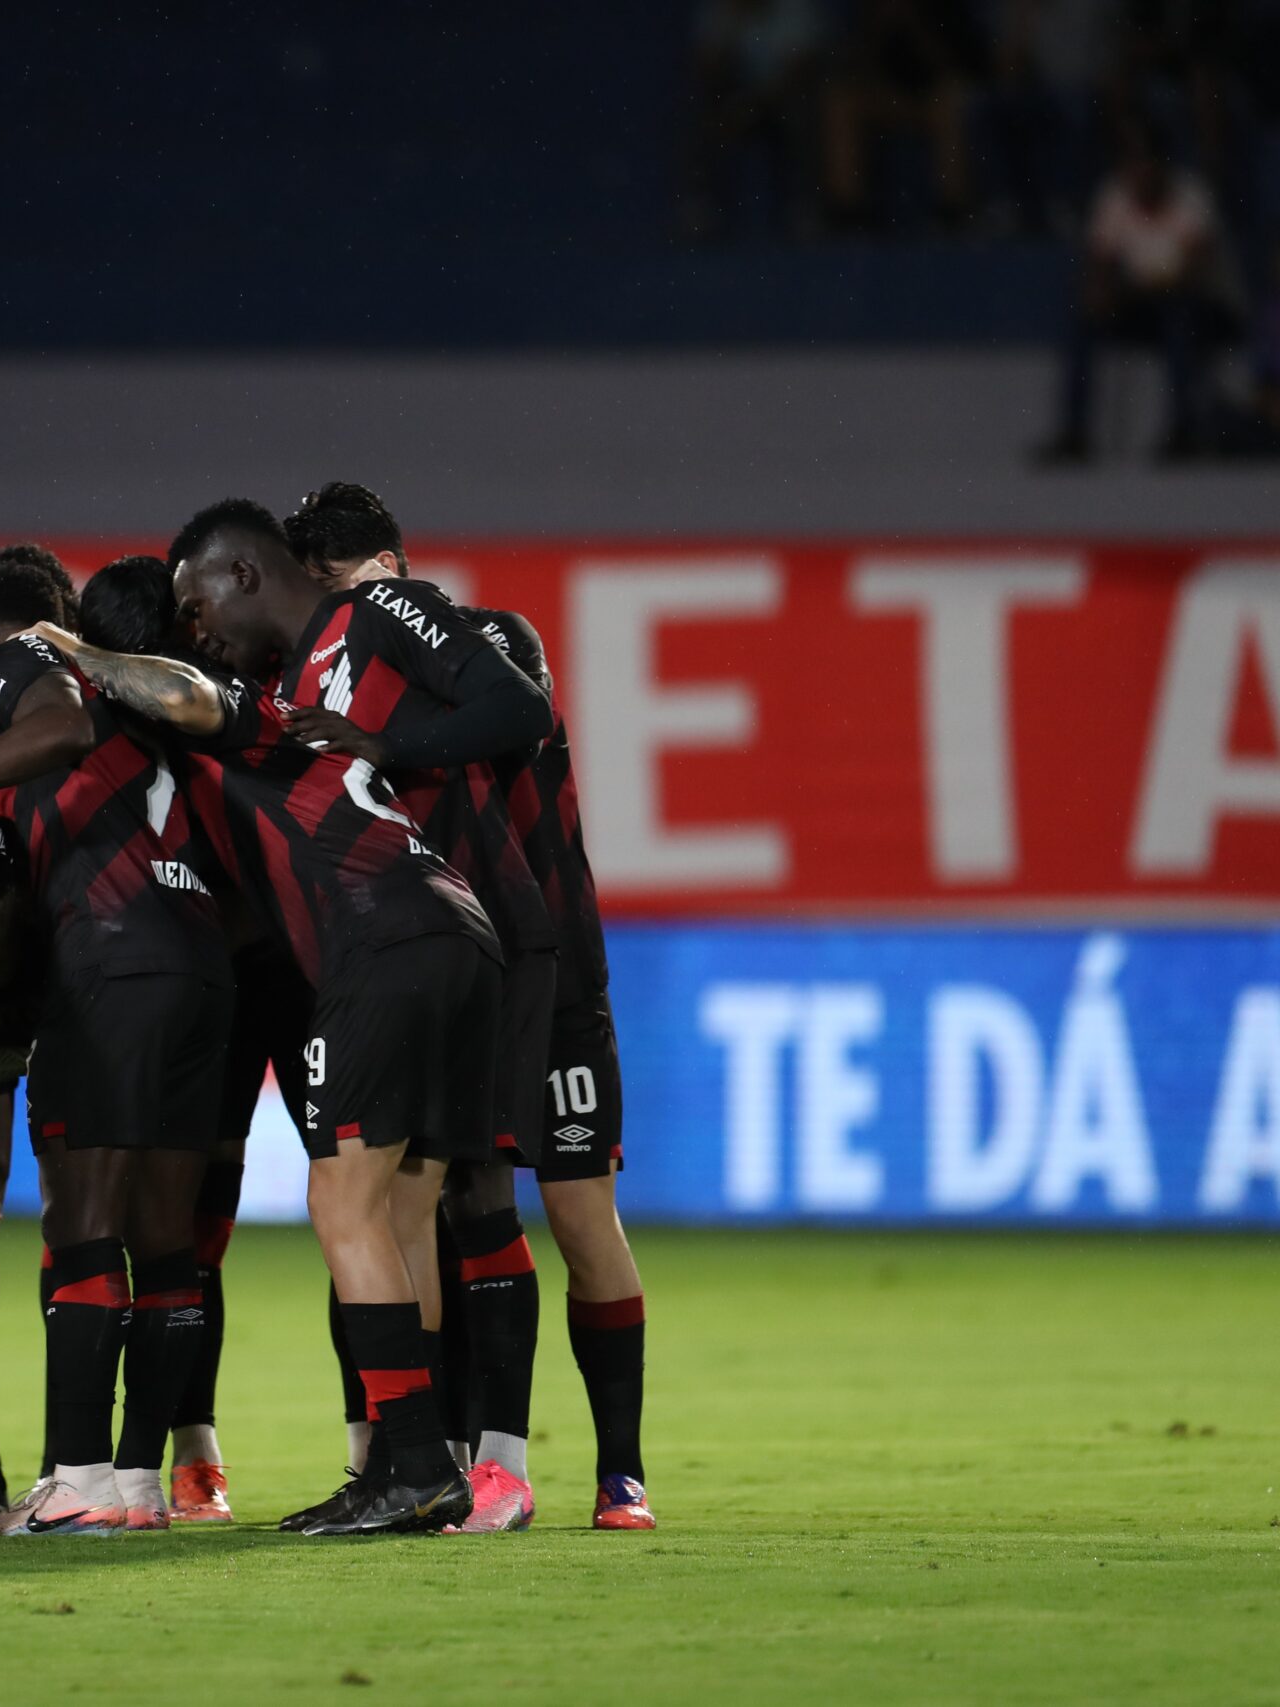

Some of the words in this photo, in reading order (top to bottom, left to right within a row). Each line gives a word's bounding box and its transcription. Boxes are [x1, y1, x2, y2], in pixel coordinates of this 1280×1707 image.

[366, 583, 449, 650] HAVAN
[481, 621, 511, 655] HAV
[303, 1037, 326, 1086] 9
[700, 985, 884, 1212] TE
[926, 932, 1158, 1212] DÁ
[546, 1065, 598, 1117] 10
[556, 1143, 592, 1152] umbro
